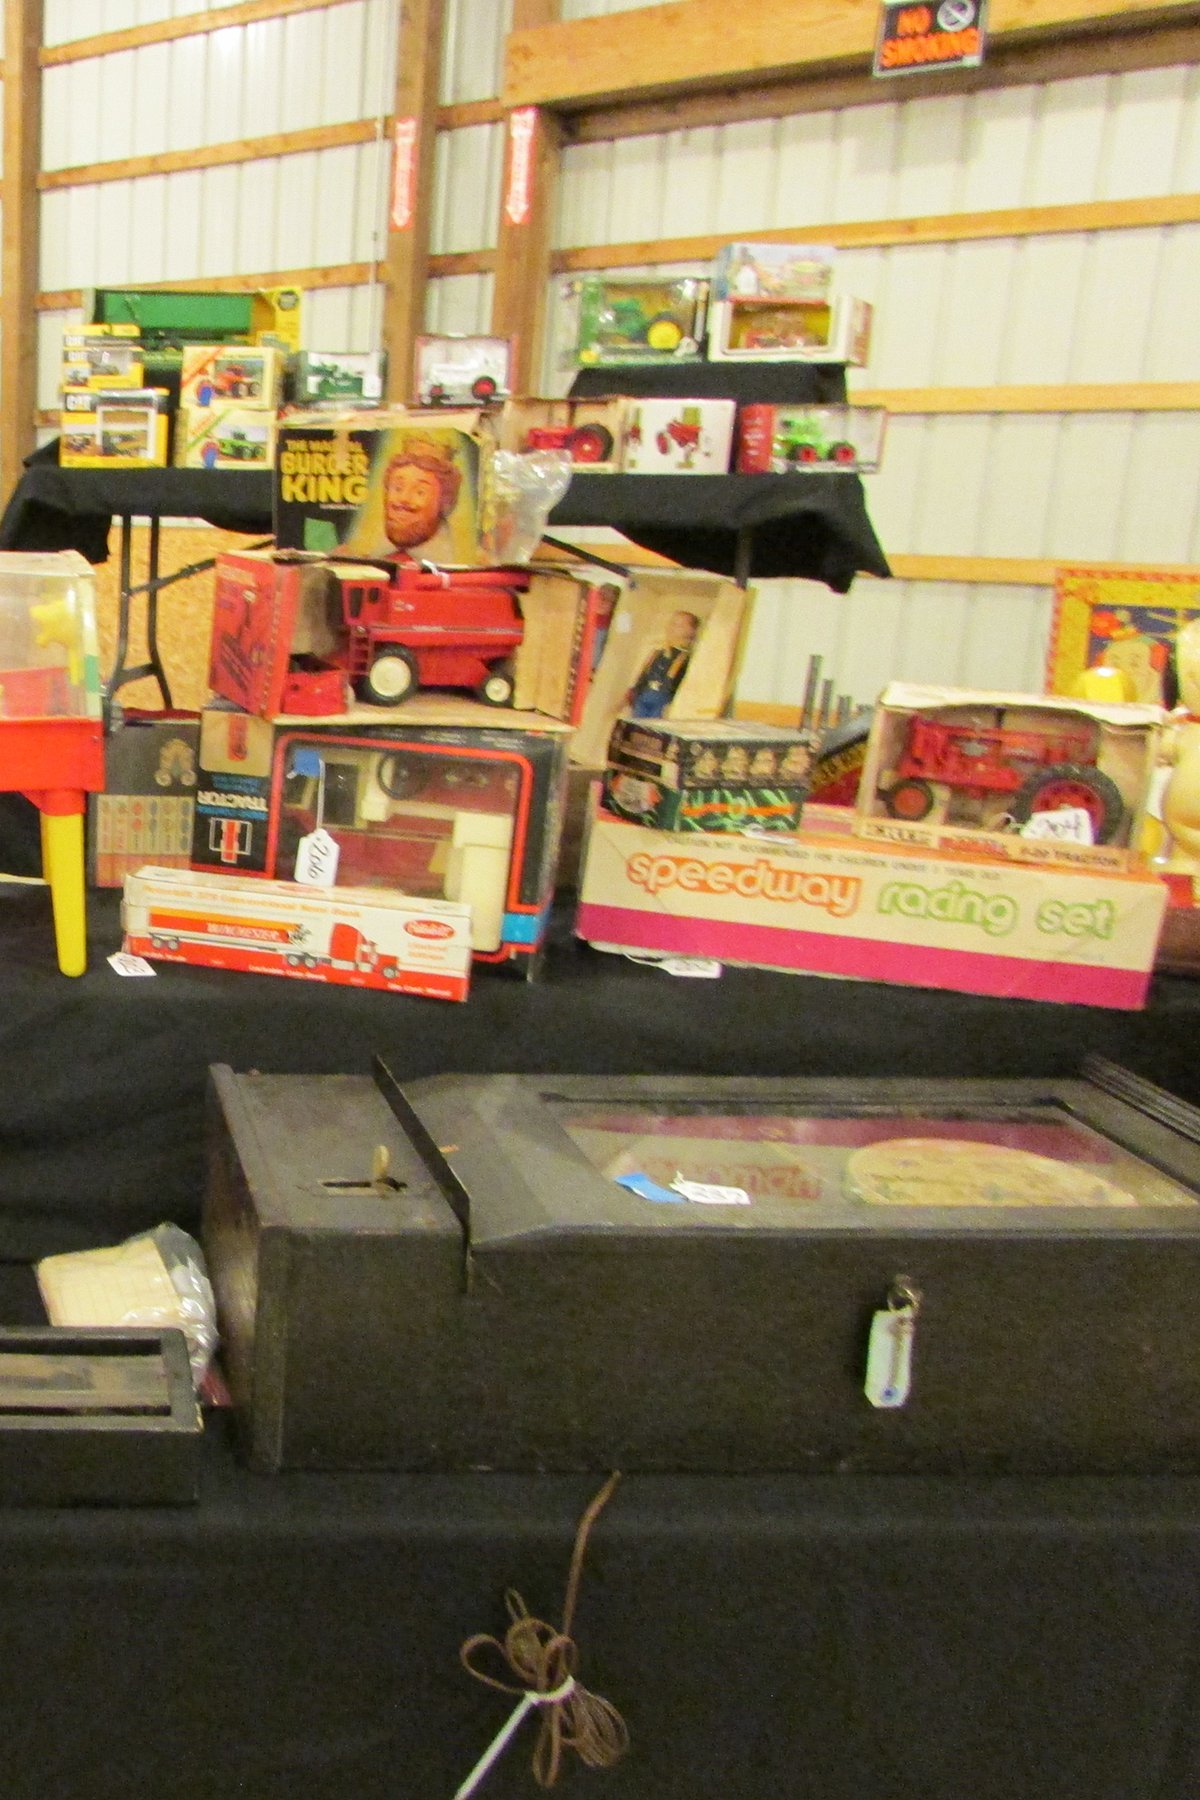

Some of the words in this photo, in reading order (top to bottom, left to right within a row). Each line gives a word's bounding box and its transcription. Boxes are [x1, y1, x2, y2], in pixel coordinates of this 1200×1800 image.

[898, 5, 931, 34] NO
[881, 27, 979, 67] SMOKING
[286, 439, 308, 452] THE
[282, 474, 369, 504] KING
[628, 853, 862, 918] speedway
[876, 880, 1018, 936] racing
[1036, 898, 1117, 940] set
[206, 922, 282, 942] WINCHESTER
